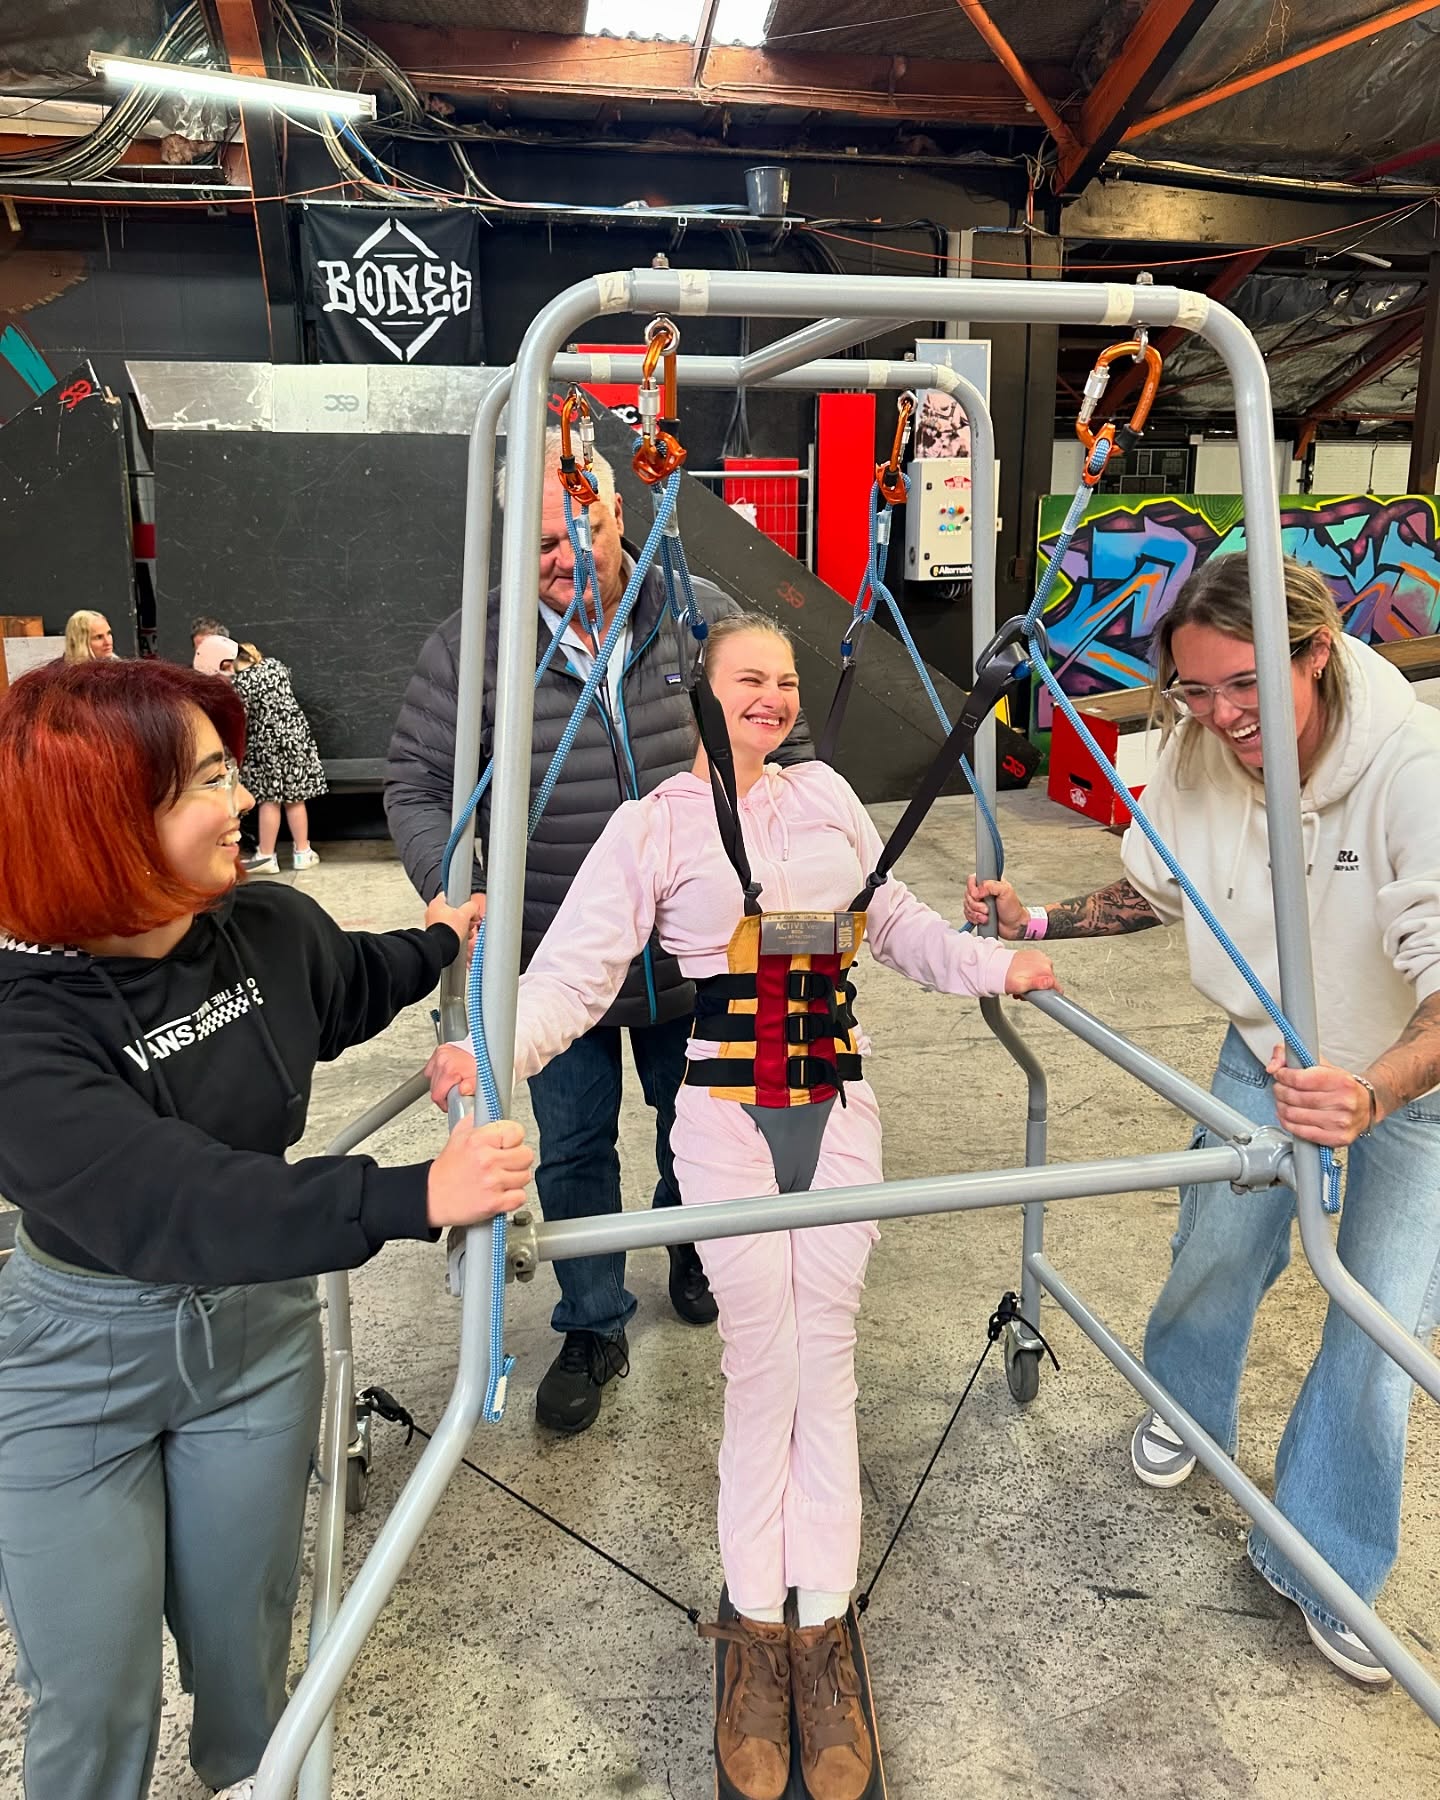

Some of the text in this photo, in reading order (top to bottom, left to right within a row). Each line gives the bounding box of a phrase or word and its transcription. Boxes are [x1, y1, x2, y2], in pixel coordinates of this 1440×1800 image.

[317, 260, 472, 316] BONES
[775, 922, 804, 931] ACTIVE
[838, 926, 853, 948] KIDS
[234, 977, 256, 995] OF
[210, 989, 234, 1007] THE
[123, 1020, 196, 1071] VANS
